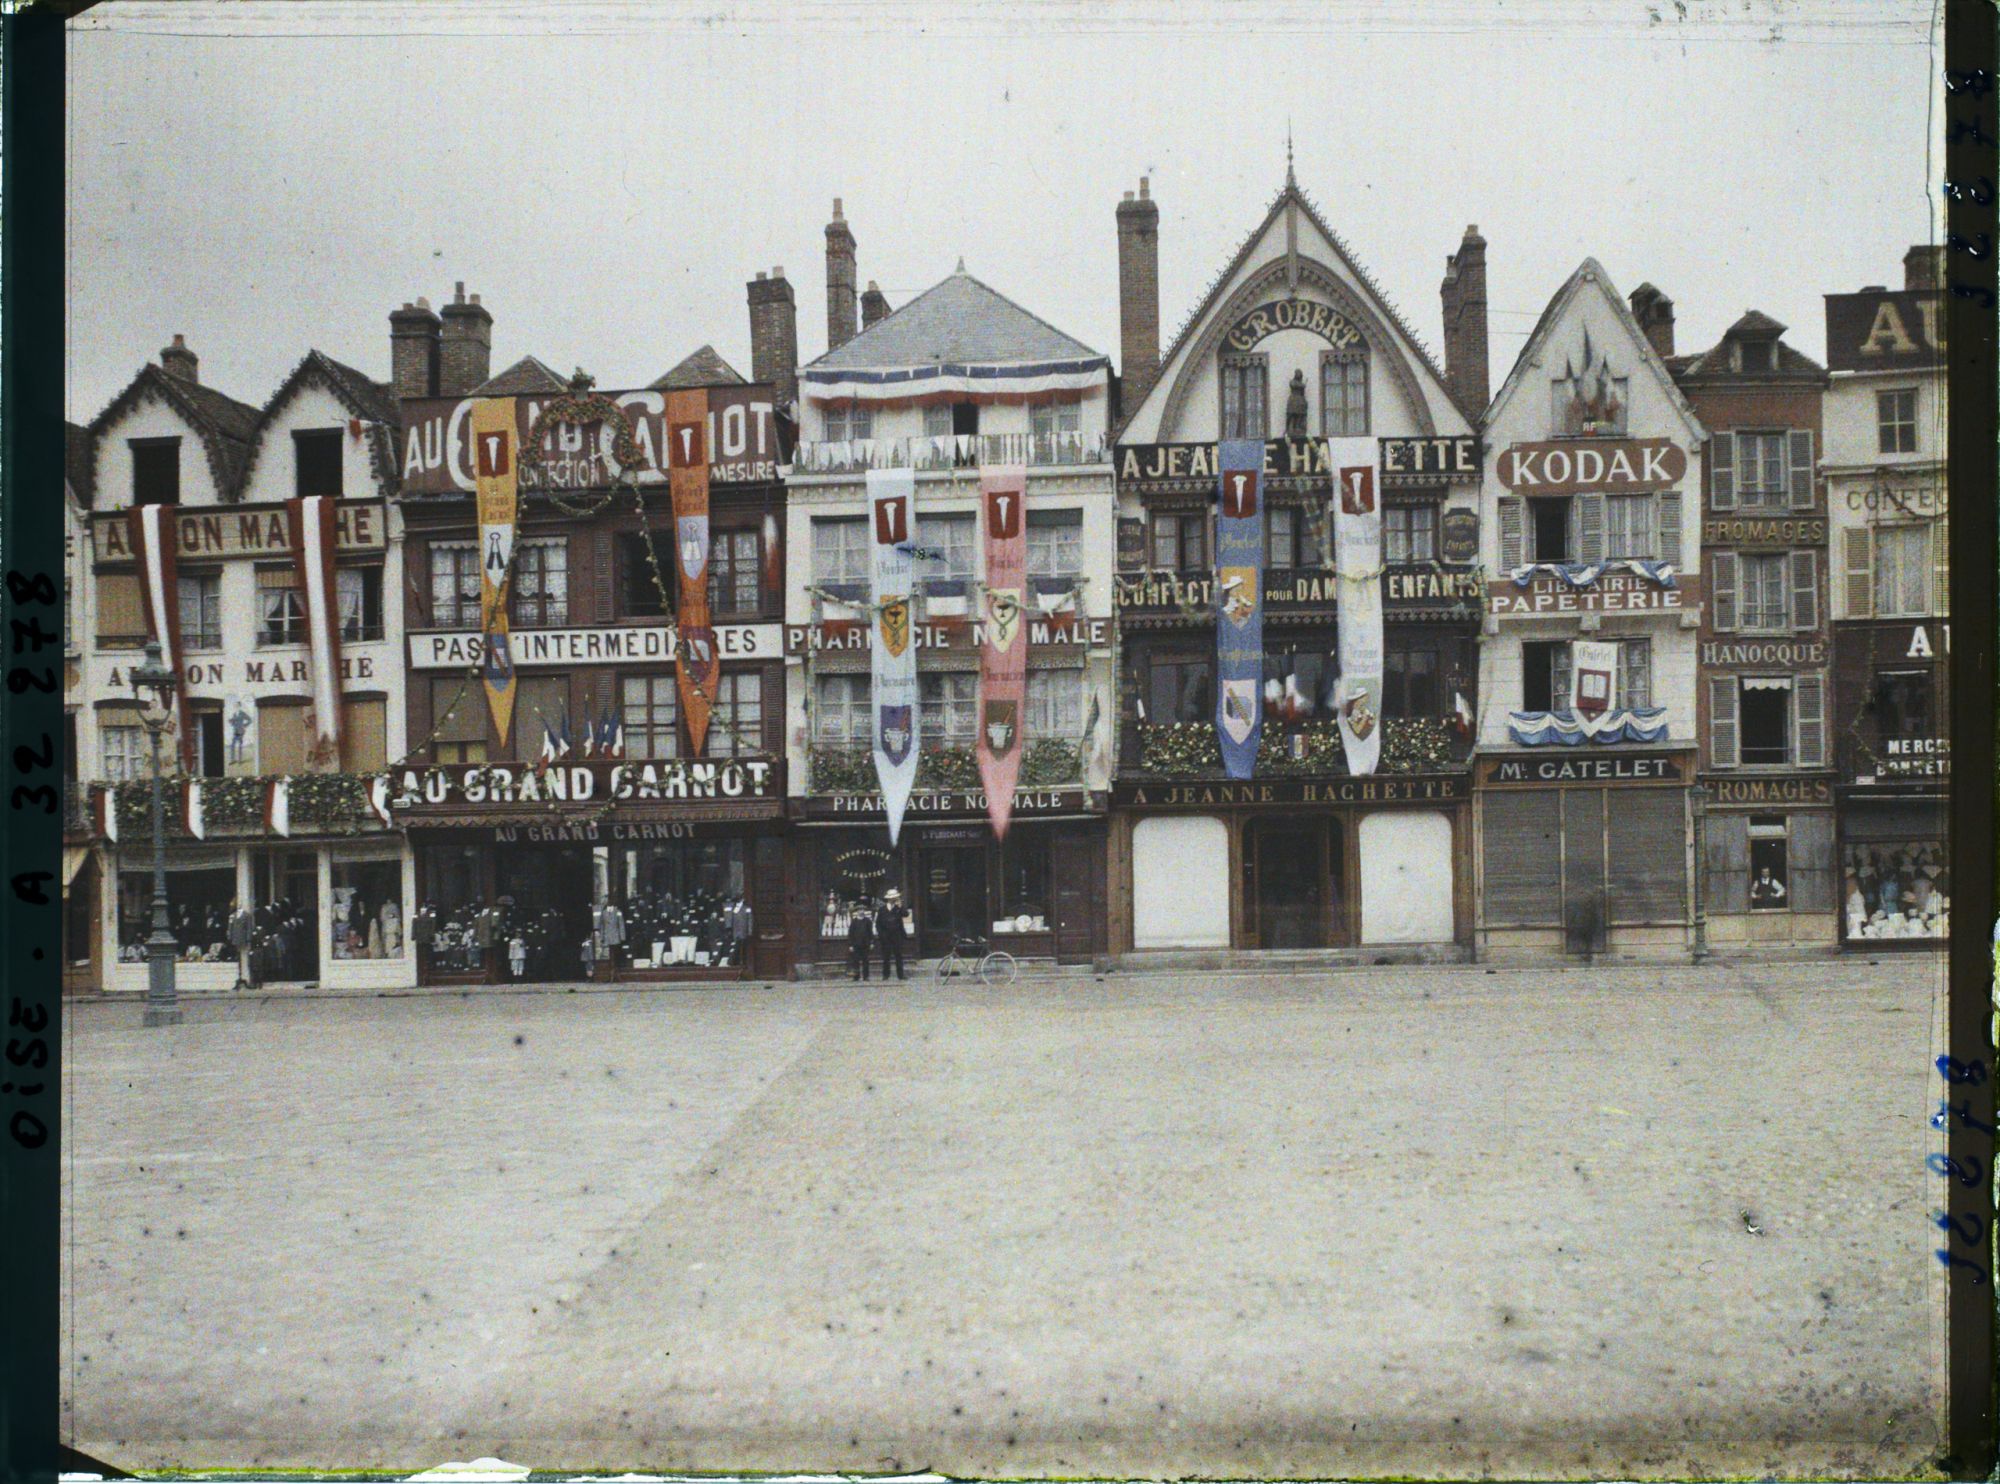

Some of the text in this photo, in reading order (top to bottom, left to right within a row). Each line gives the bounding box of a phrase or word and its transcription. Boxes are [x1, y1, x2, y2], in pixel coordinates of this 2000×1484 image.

[404, 416, 442, 480] AU
[1121, 439, 1475, 479] A JEAE HAETTE
[710, 460, 776, 482] MESURE
[1511, 447, 1673, 486] KODAK
[1704, 520, 1824, 540] FROMAGES
[1265, 589, 1293, 601] POUR
[1491, 590, 1682, 613] PAPETERIE
[6, 569, 58, 696] 278
[789, 620, 1106, 651] PHARCIE NMALE
[432, 636, 482, 663] PAS
[1702, 641, 1825, 666] HANOCQUE
[1538, 759, 1669, 779] GATELET
[402, 761, 770, 804] AU GRAND CARNOT
[1133, 780, 1456, 804] A JEANNE HACHETTE
[1703, 780, 1829, 801] FROMAGES
[832, 795, 952, 813] PHARACIE
[496, 822, 696, 843] AU GRAND CARNOT
[11, 870, 53, 906] A
